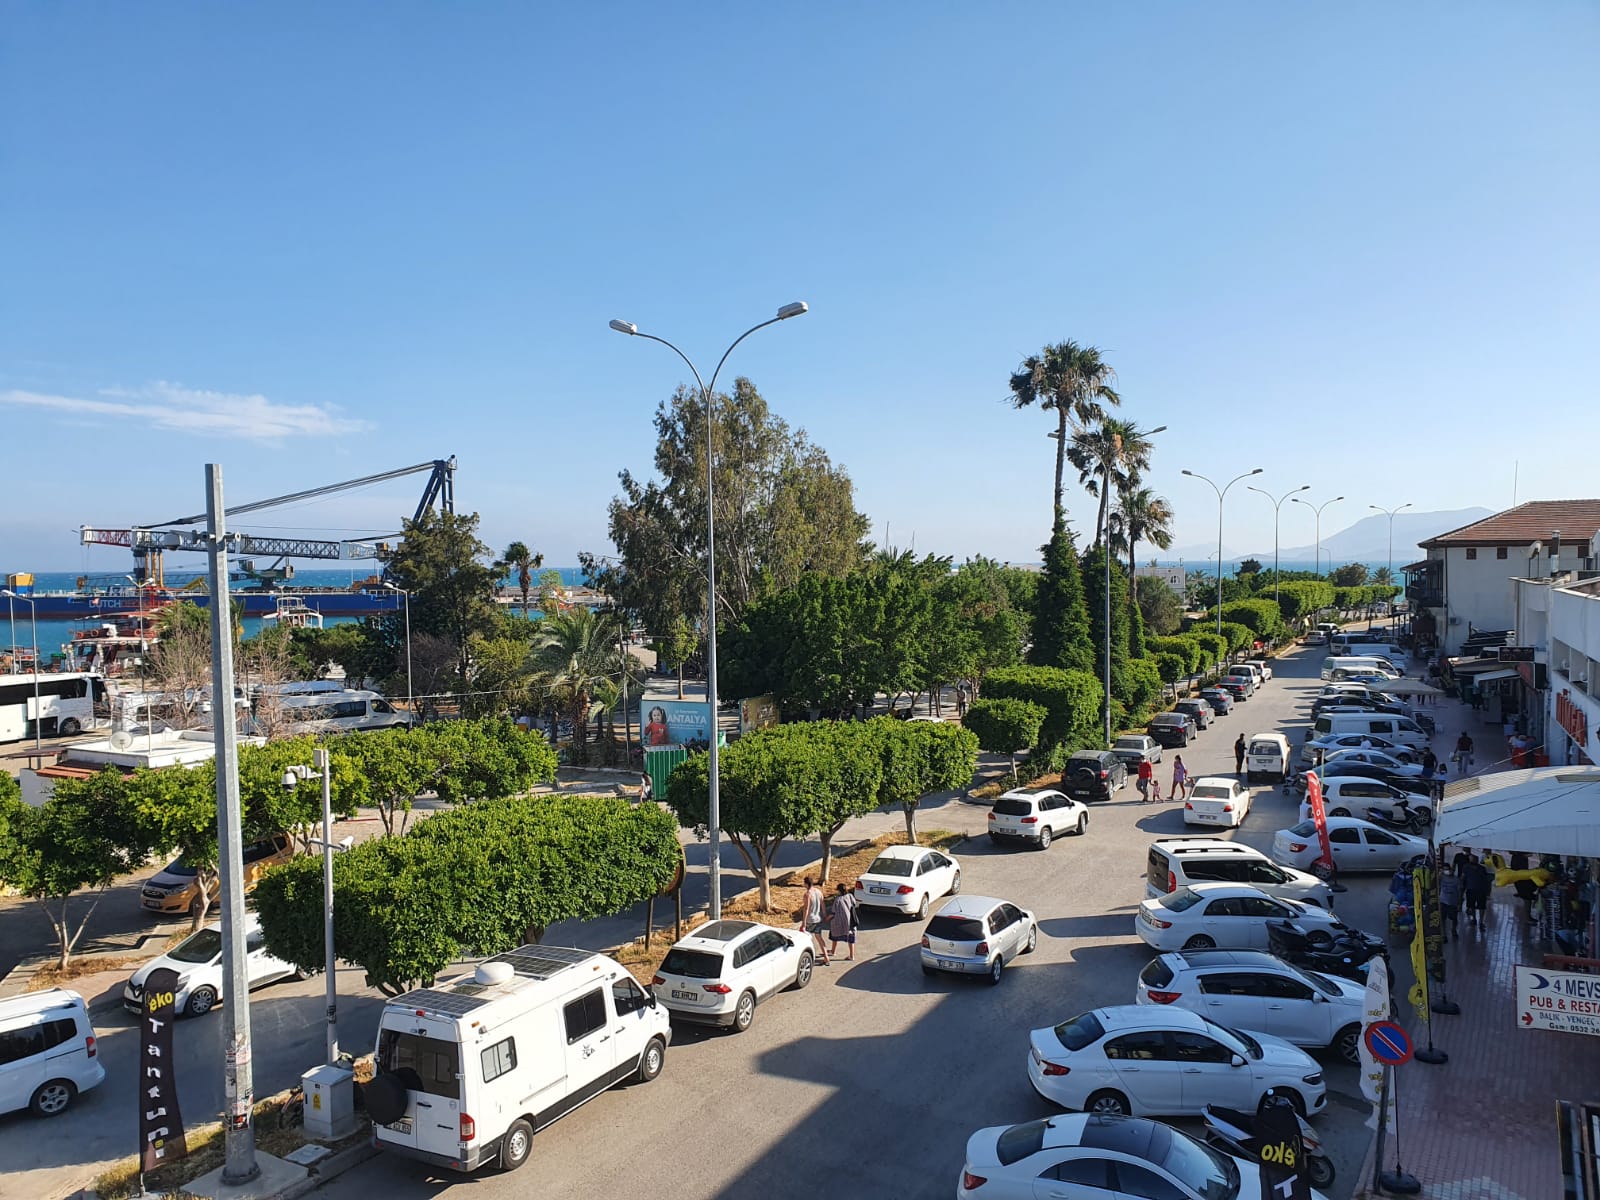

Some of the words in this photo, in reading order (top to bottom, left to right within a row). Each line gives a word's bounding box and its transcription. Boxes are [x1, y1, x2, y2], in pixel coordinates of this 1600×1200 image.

[667, 714, 707, 725] ANTALYA
[1554, 980, 1561, 992] 4
[149, 991, 174, 1012] eko
[1530, 995, 1553, 1008] PUB
[1558, 999, 1566, 1010] &
